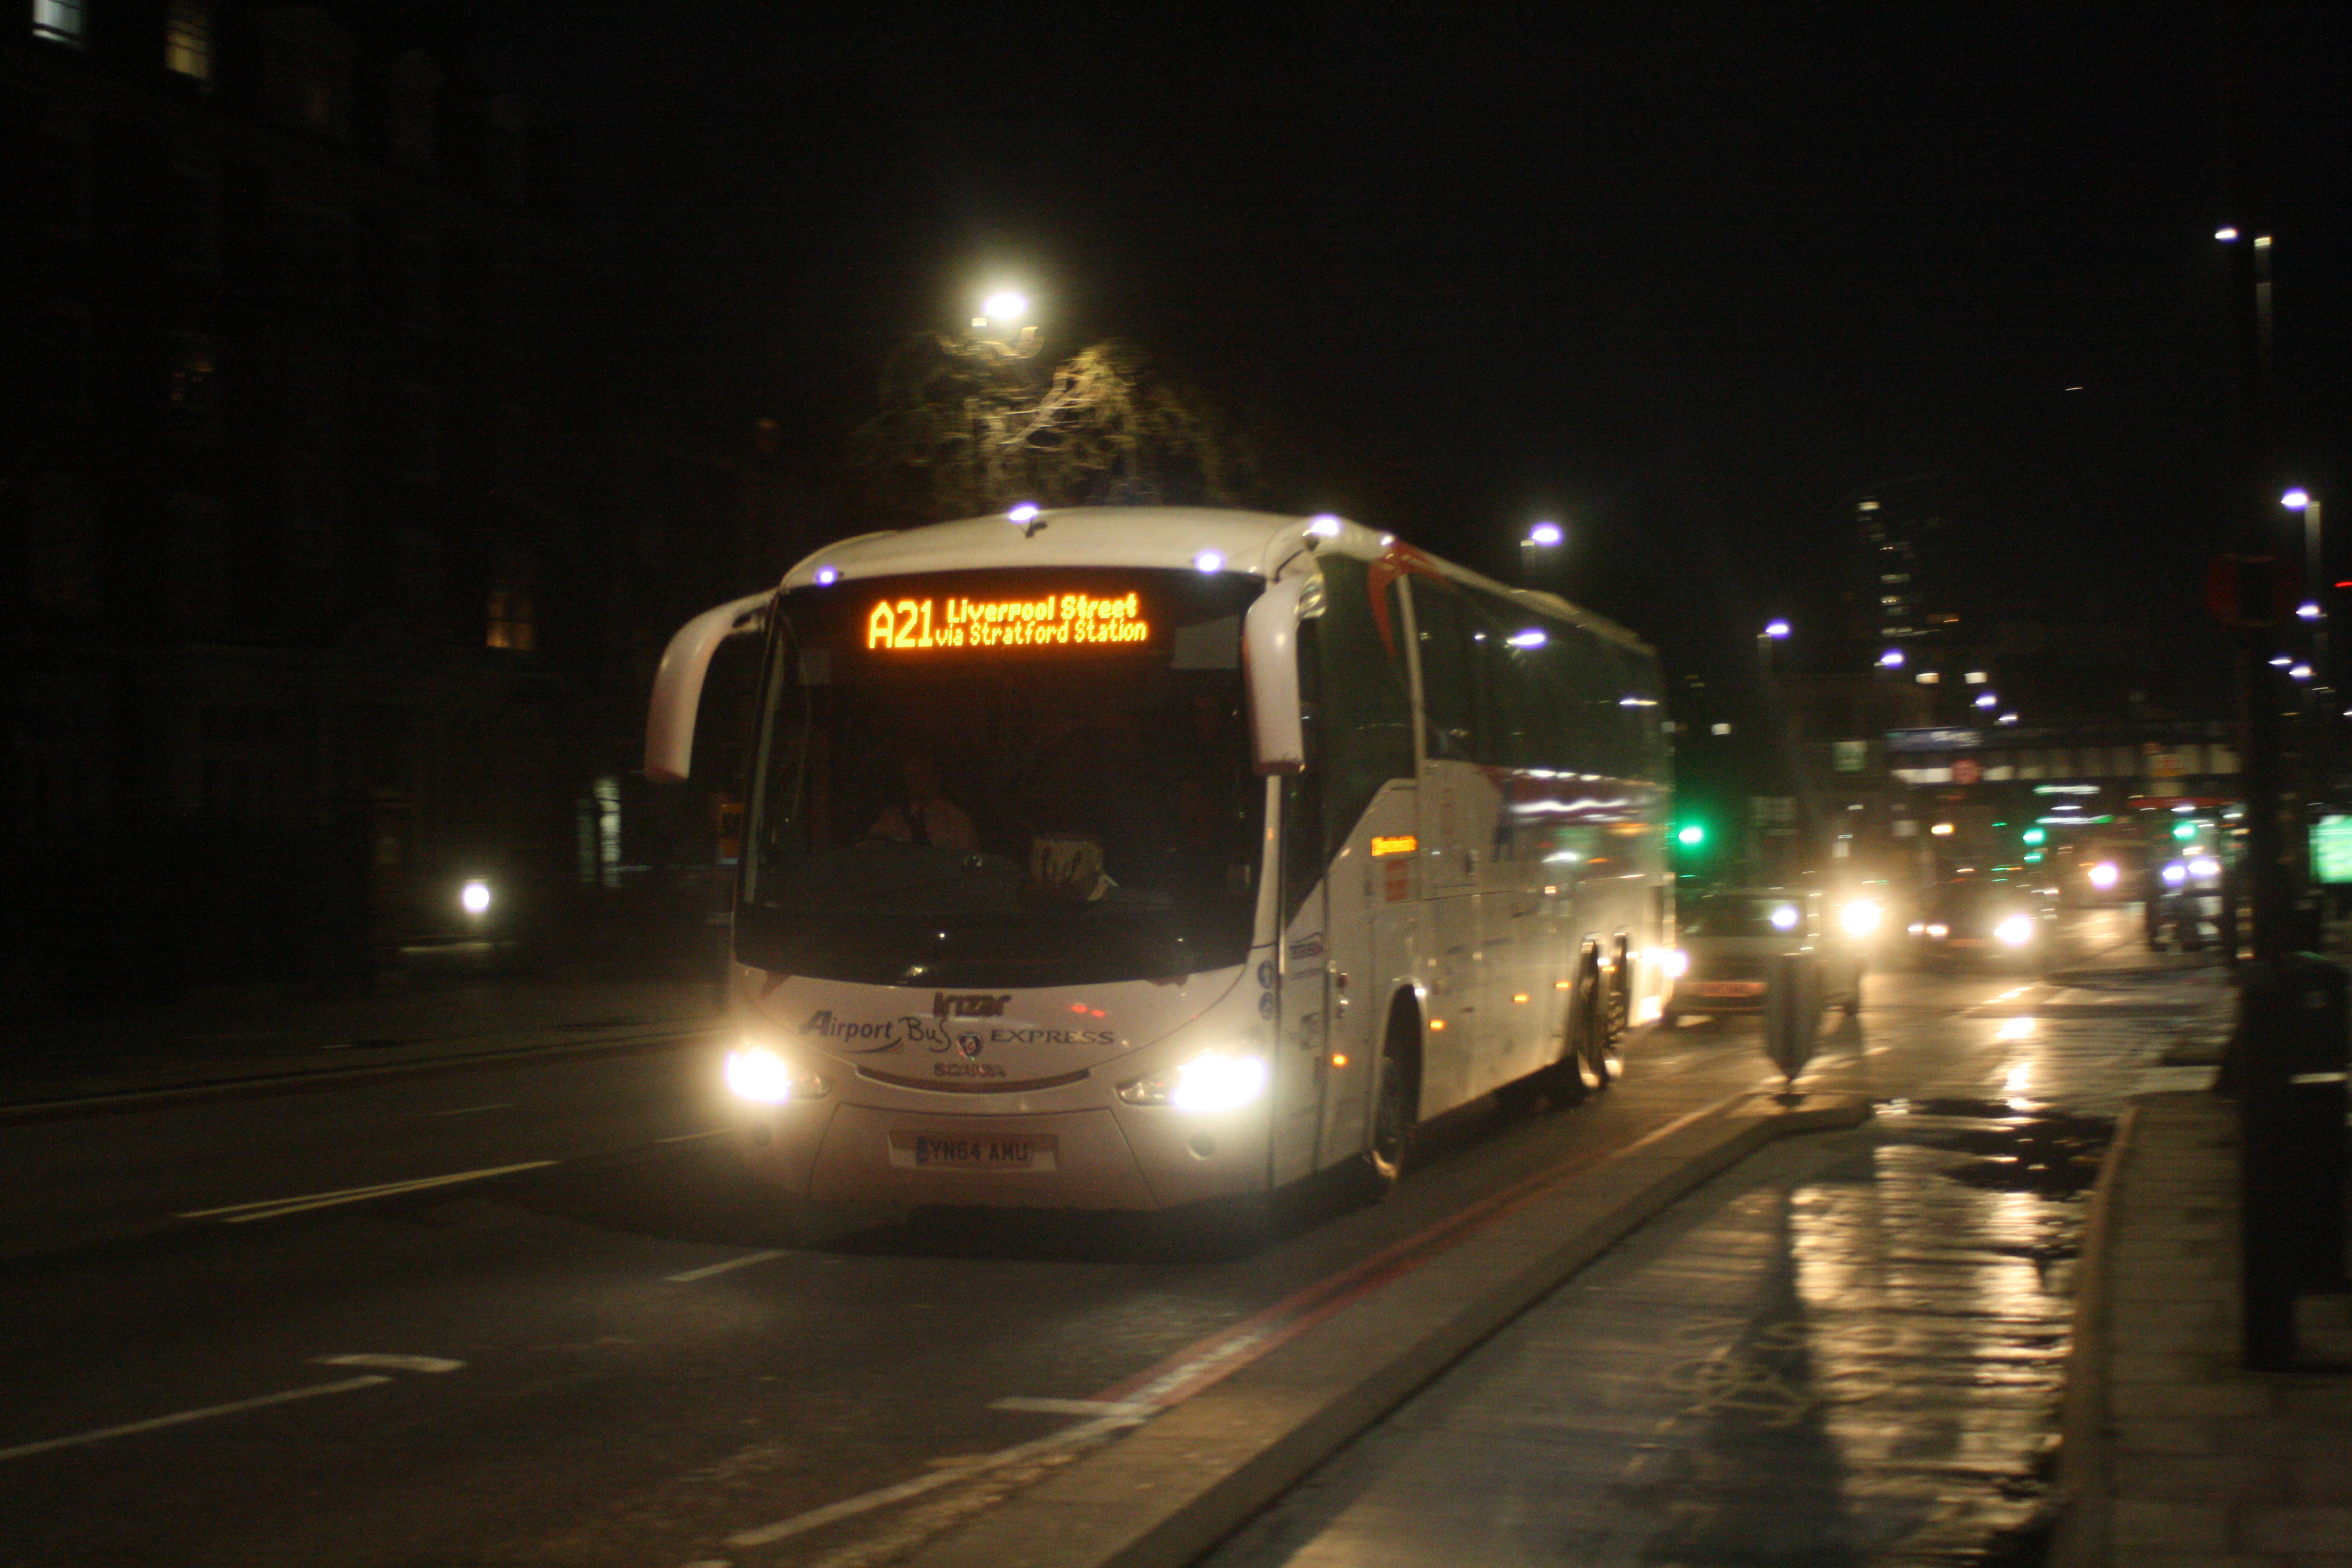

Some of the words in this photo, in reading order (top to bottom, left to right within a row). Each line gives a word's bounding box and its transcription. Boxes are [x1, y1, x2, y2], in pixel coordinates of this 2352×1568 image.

[868, 599, 933, 648] A21
[947, 596, 1055, 624] Liverpool
[1060, 593, 1138, 620] Street
[935, 623, 964, 647] via
[970, 620, 1069, 645] Stratford
[1074, 618, 1148, 643] Station
[800, 1009, 893, 1042] Airport
[898, 1016, 952, 1053] Bus
[990, 1029, 1116, 1044] EXPRESS
